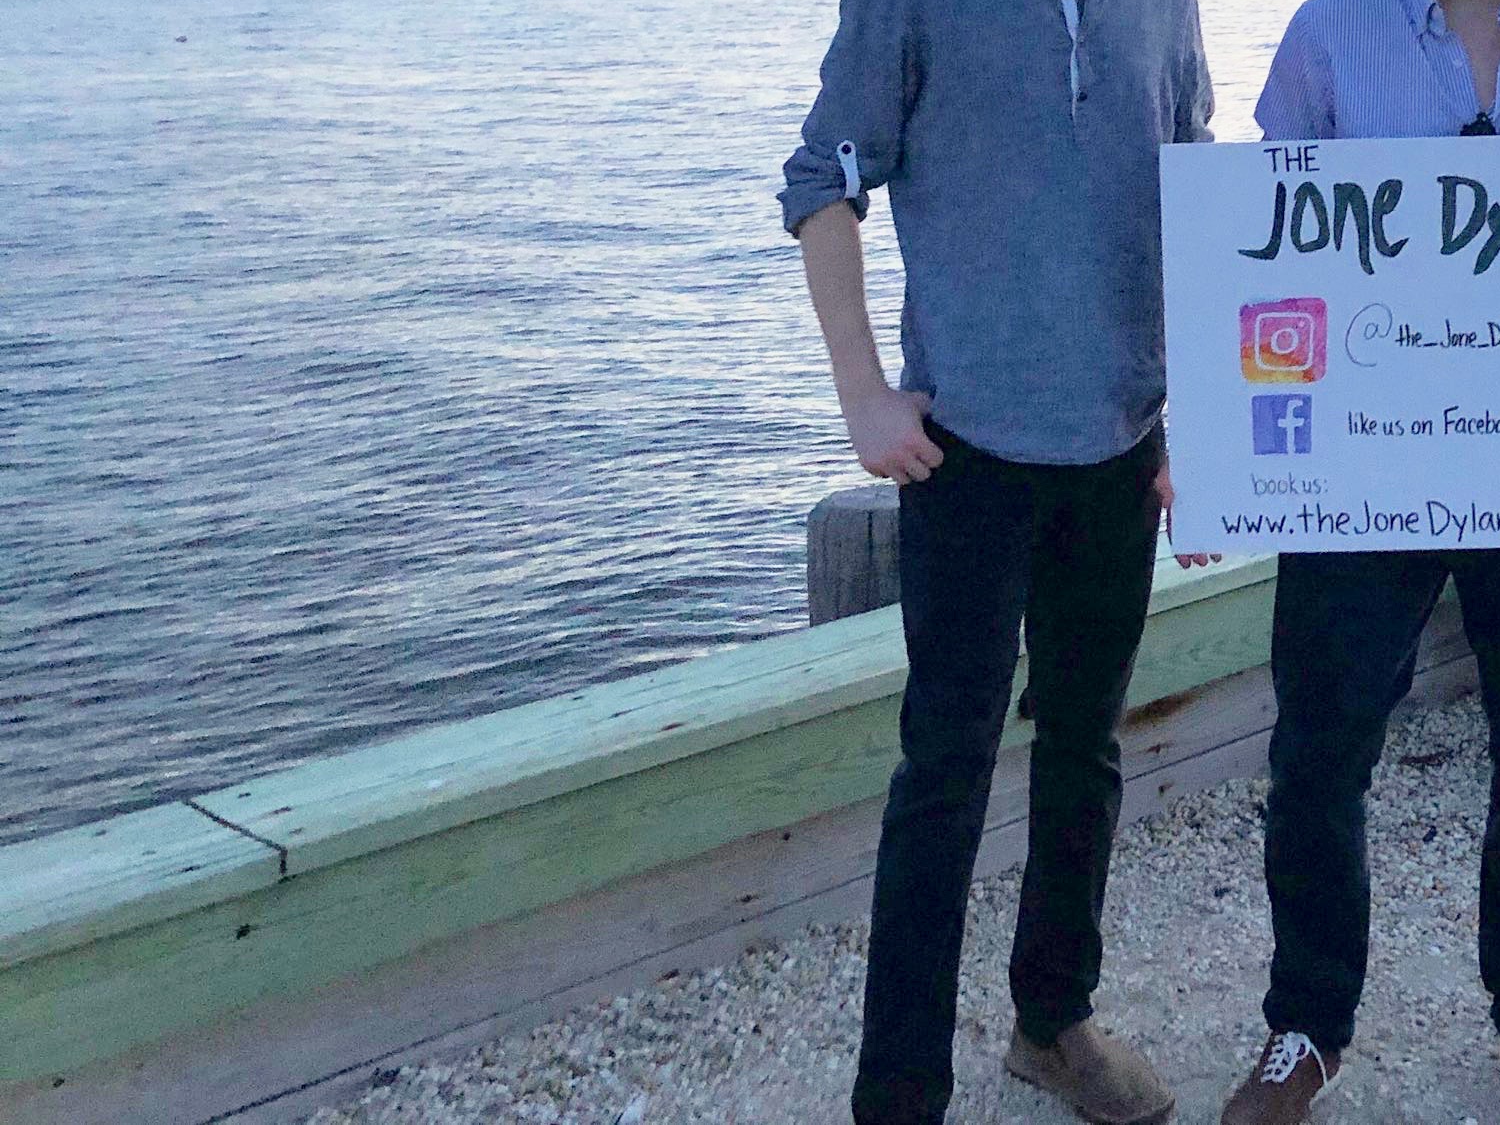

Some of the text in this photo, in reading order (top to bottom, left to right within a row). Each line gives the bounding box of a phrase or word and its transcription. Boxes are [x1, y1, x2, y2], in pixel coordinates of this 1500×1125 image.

[1263, 145, 1320, 172] THE
[1347, 410, 1377, 435] like
[1383, 417, 1405, 436] us
[1410, 418, 1433, 436] on
[1251, 471, 1329, 496] book us:
